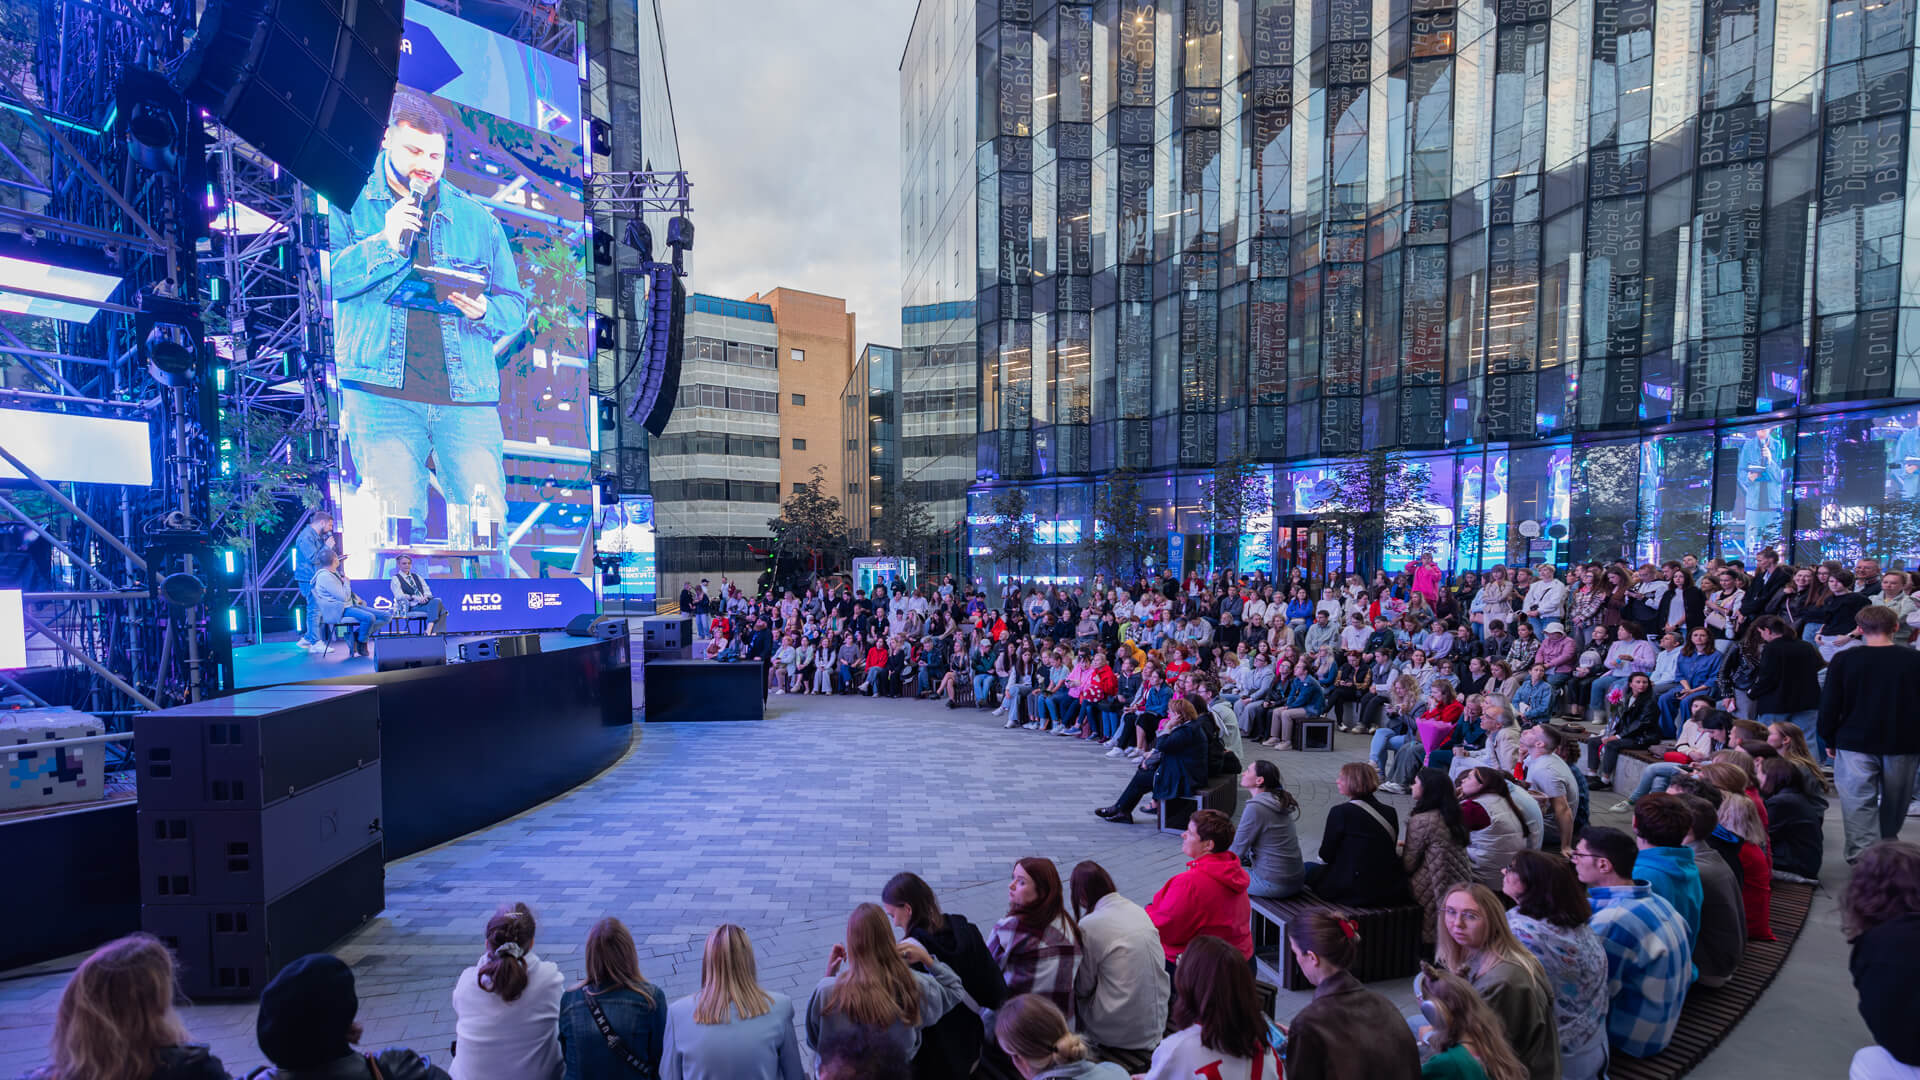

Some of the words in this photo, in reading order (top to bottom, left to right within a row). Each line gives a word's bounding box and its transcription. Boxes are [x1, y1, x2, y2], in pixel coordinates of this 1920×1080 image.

[1272, 15, 1291, 65] Hello
[1341, 2, 1353, 40] World
[1329, 44, 1341, 70] Hello
[1340, 43, 1353, 83] Digital
[1136, 60, 1153, 104] Hello
[1276, 69, 1291, 104] BMS
[1843, 134, 1872, 190] Digital
[1699, 180, 1722, 239] Hello
[1603, 208, 1622, 257] Digital
[1414, 306, 1426, 355] Bauman
[1260, 332, 1271, 377] Bauman
[462, 594, 502, 604] ЛЕТО
